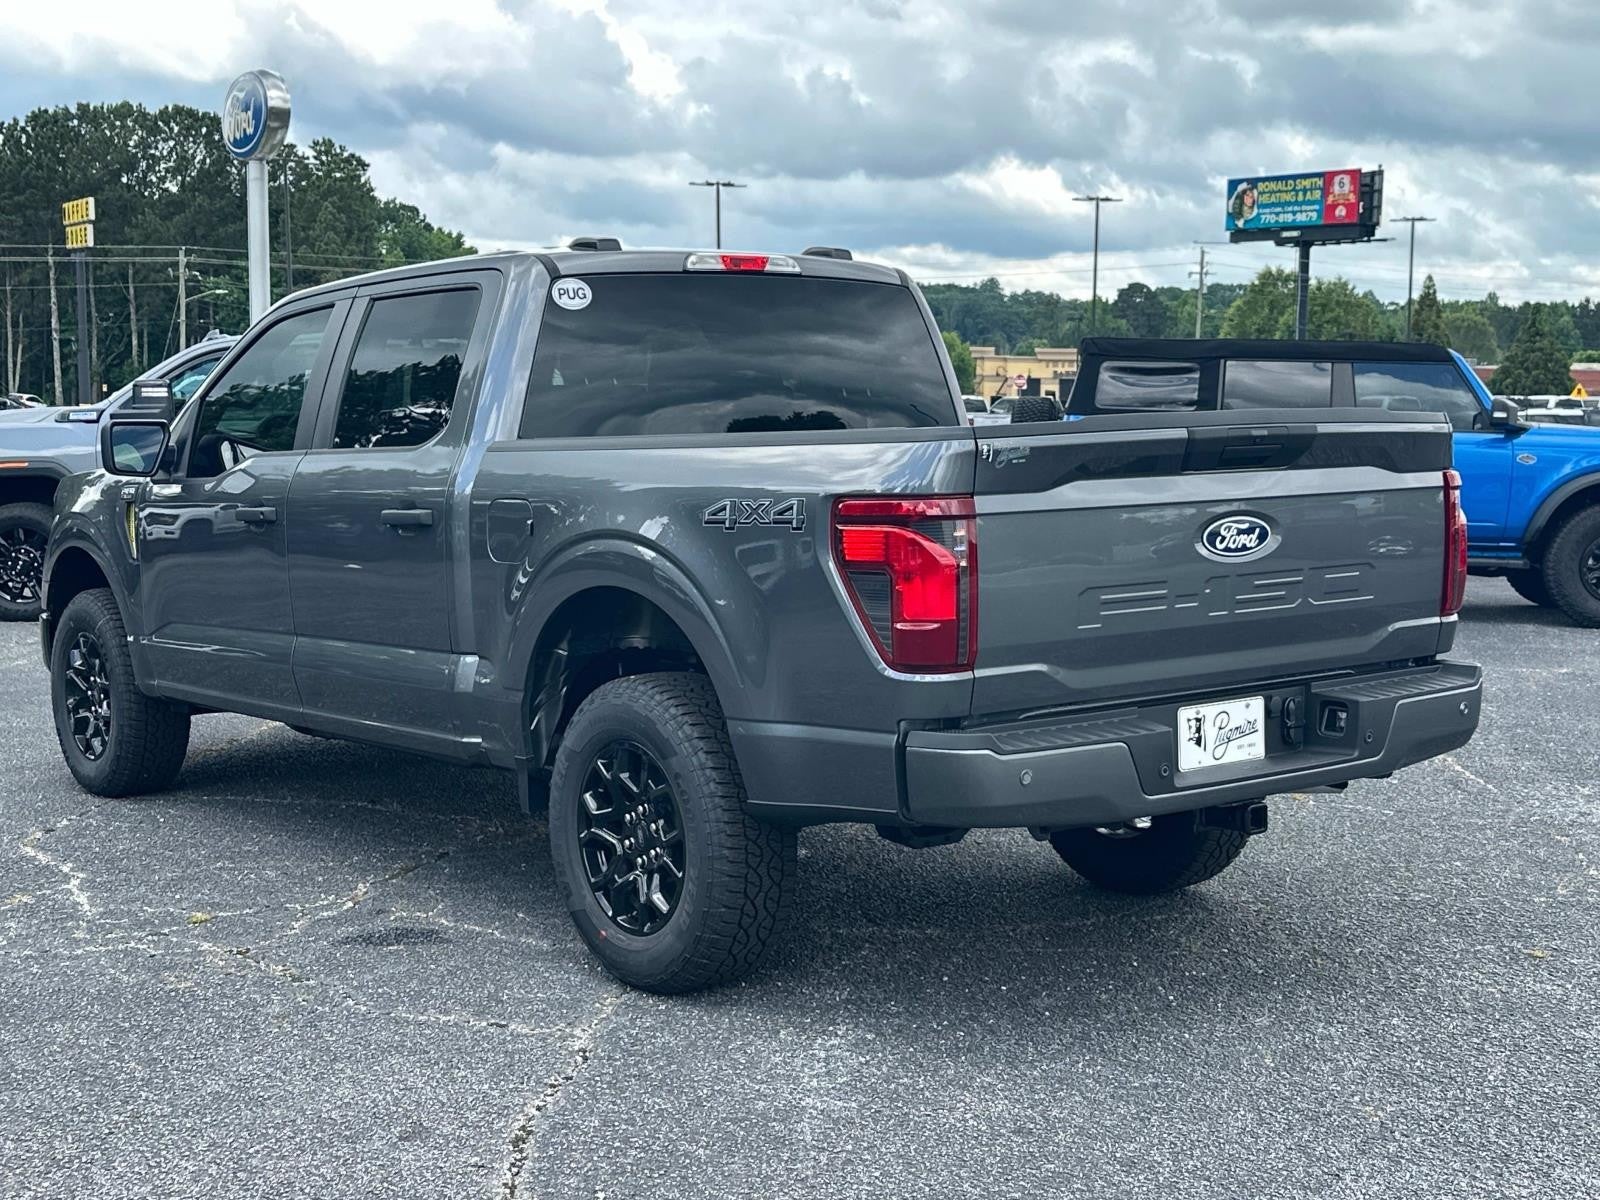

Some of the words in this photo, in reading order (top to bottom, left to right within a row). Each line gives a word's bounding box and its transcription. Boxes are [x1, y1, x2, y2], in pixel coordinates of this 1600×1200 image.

[1257, 179, 1295, 193] RONALD
[1295, 177, 1324, 190] SMITH
[1338, 176, 1345, 189] 6
[1258, 191, 1296, 205] HEATING
[1297, 190, 1304, 202] &
[1305, 189, 1322, 202] AIR
[557, 287, 587, 300] PUG
[1215, 522, 1260, 550] Ford
